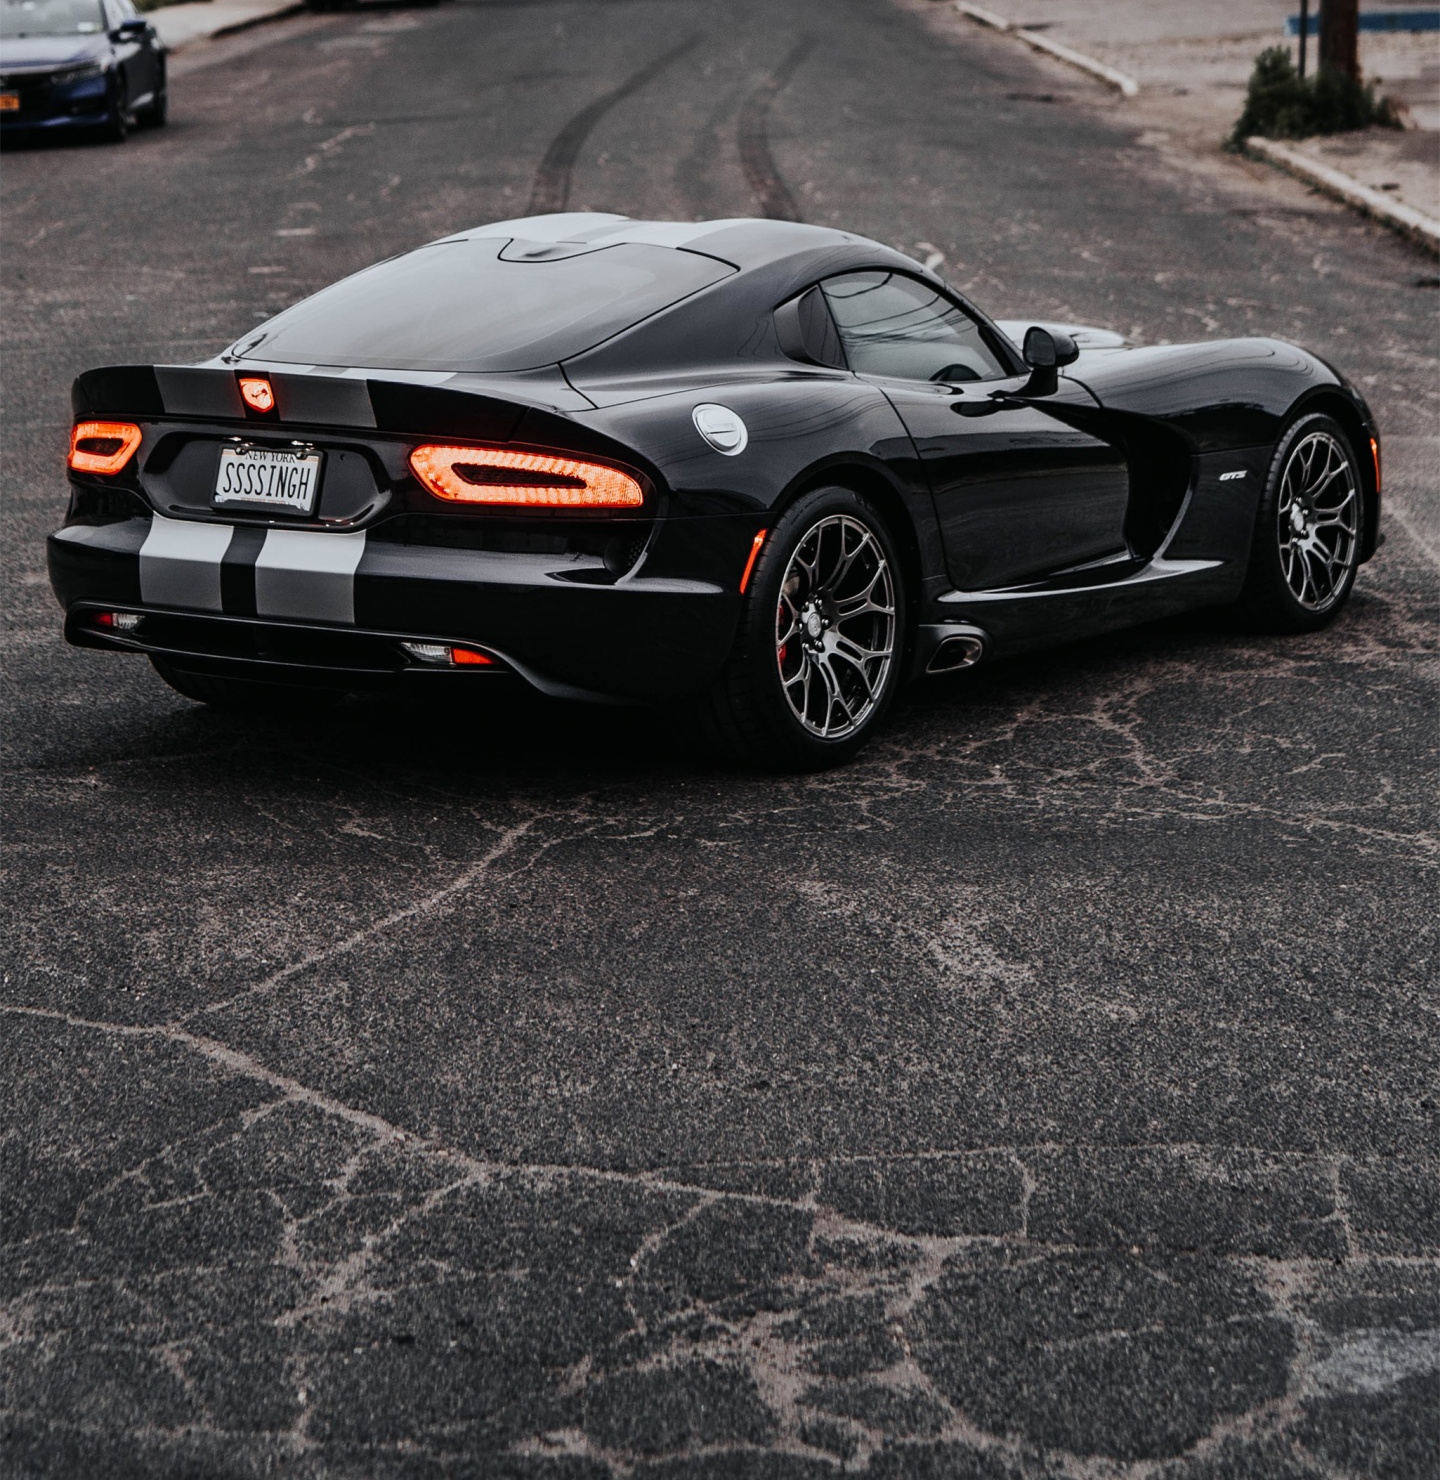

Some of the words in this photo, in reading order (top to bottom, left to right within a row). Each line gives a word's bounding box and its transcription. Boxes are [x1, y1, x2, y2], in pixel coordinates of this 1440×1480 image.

[245, 451, 267, 461] NEW
[271, 452, 296, 463] YORK
[223, 462, 311, 499] SSSSINGH
[1218, 470, 1248, 482] GTS
